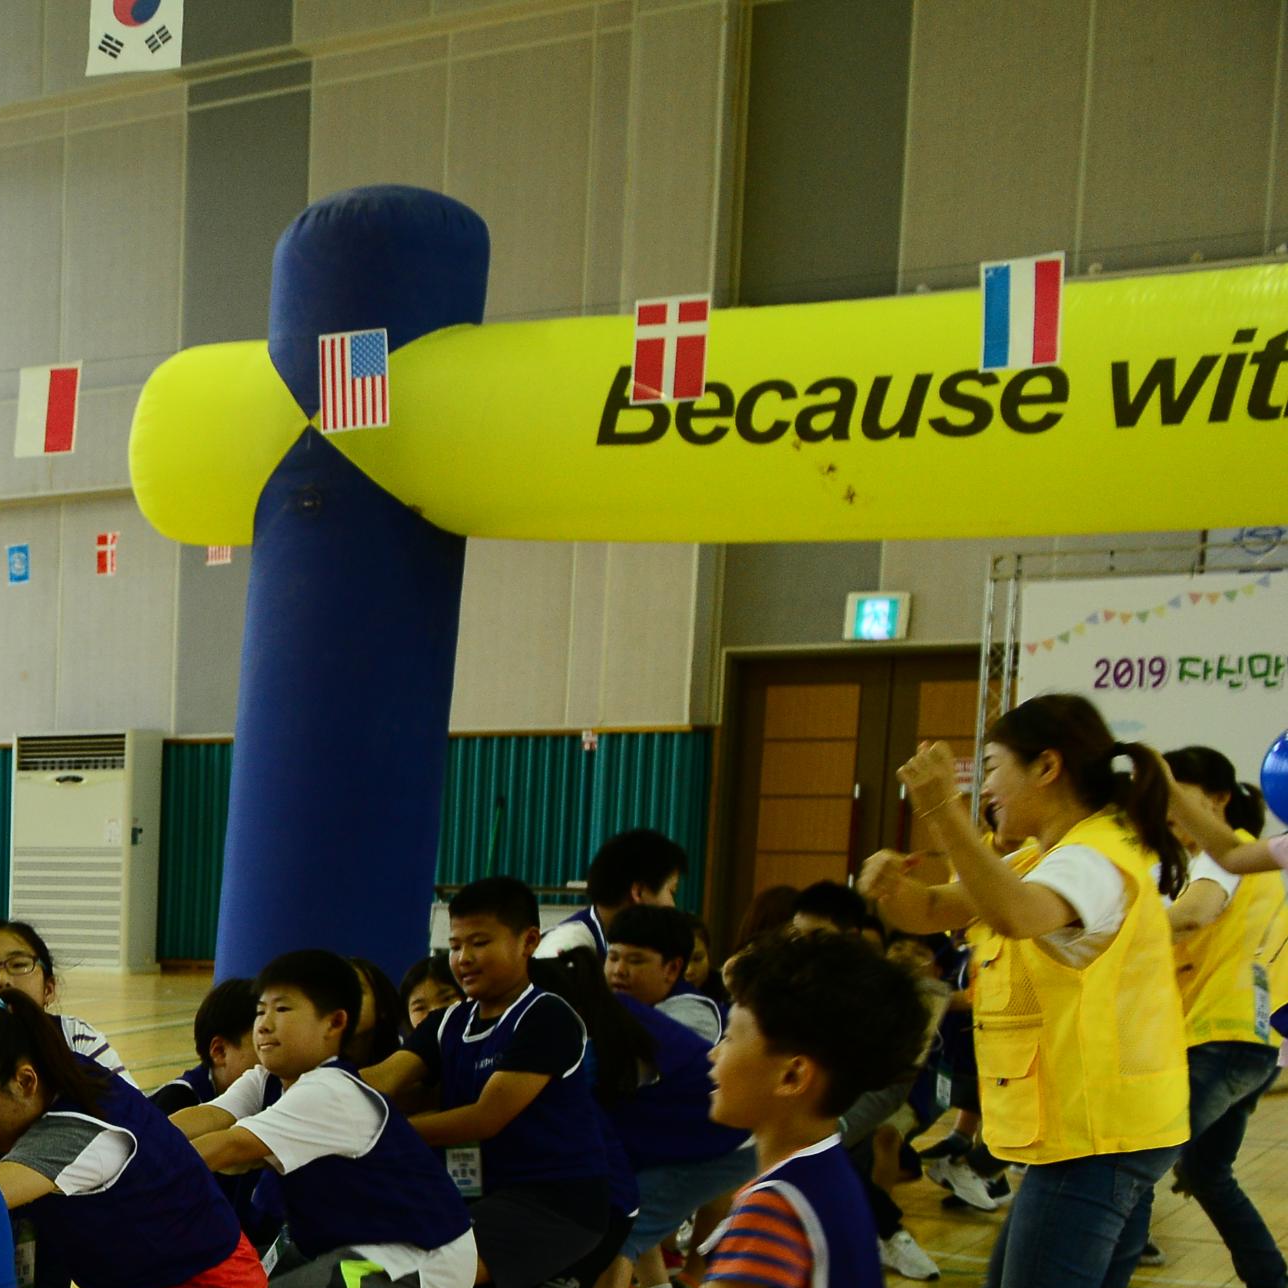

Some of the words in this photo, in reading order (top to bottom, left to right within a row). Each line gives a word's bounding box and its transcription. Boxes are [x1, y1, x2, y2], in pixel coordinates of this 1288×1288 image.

[597, 365, 1070, 446] Because
[1111, 327, 1288, 429] wit
[1093, 656, 1167, 689] 2019
